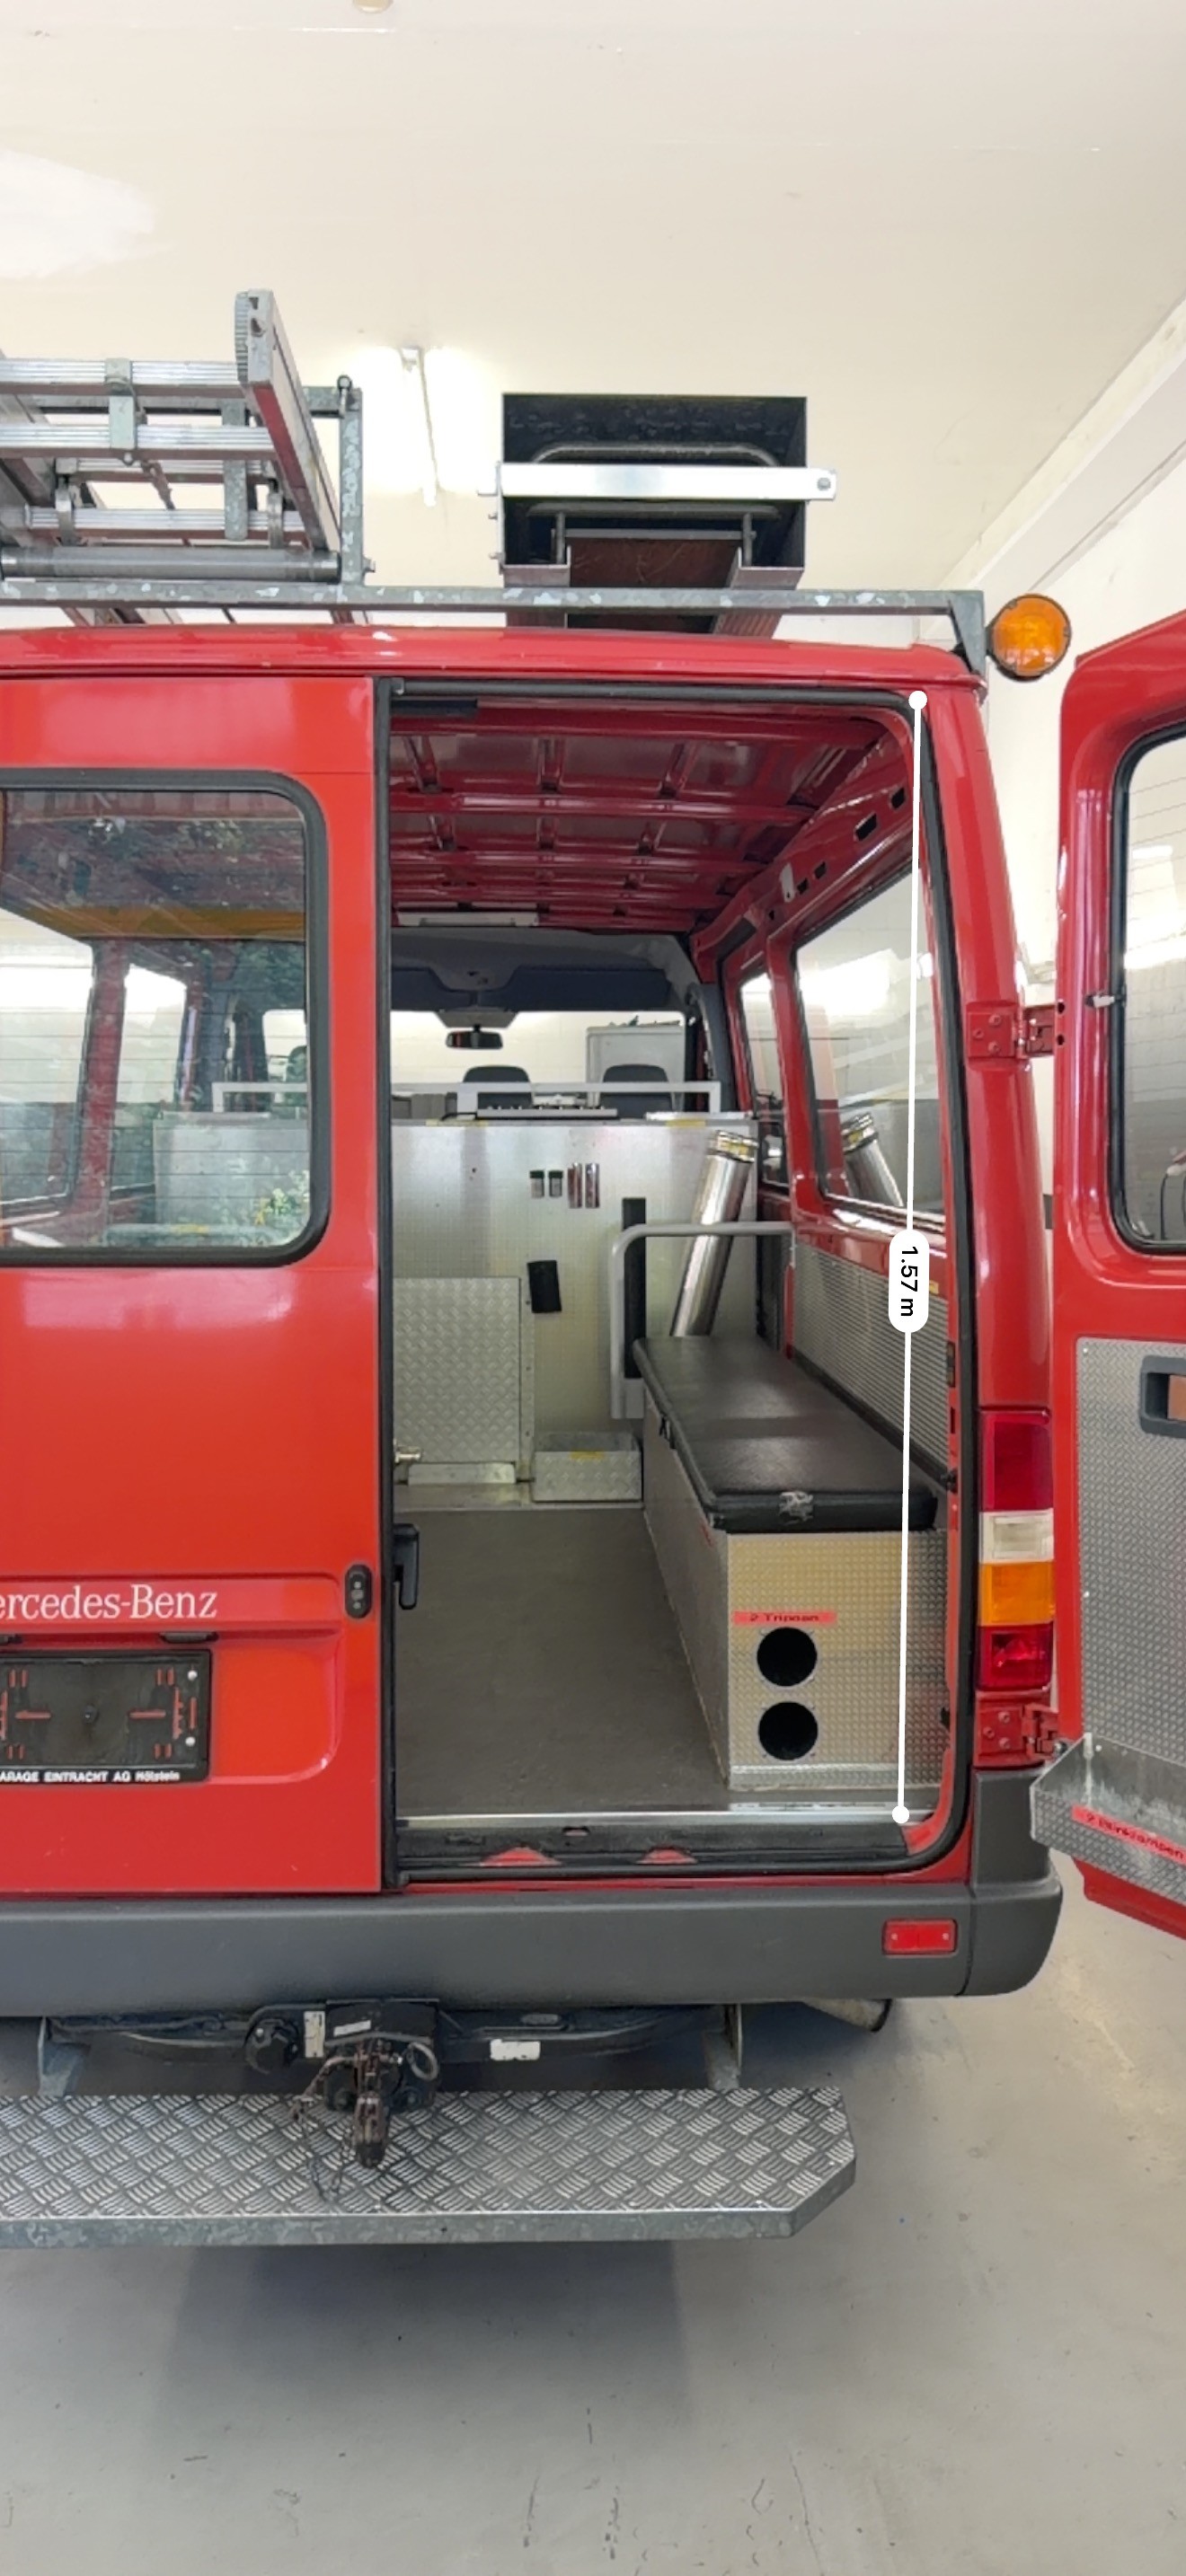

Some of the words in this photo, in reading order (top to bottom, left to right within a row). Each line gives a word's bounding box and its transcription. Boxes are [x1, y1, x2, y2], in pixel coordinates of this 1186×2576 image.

[0, 1584, 217, 1620] rcedes-Benz
[44, 1770, 109, 1783] EINTRACHT
[112, 1770, 131, 1783] AG
